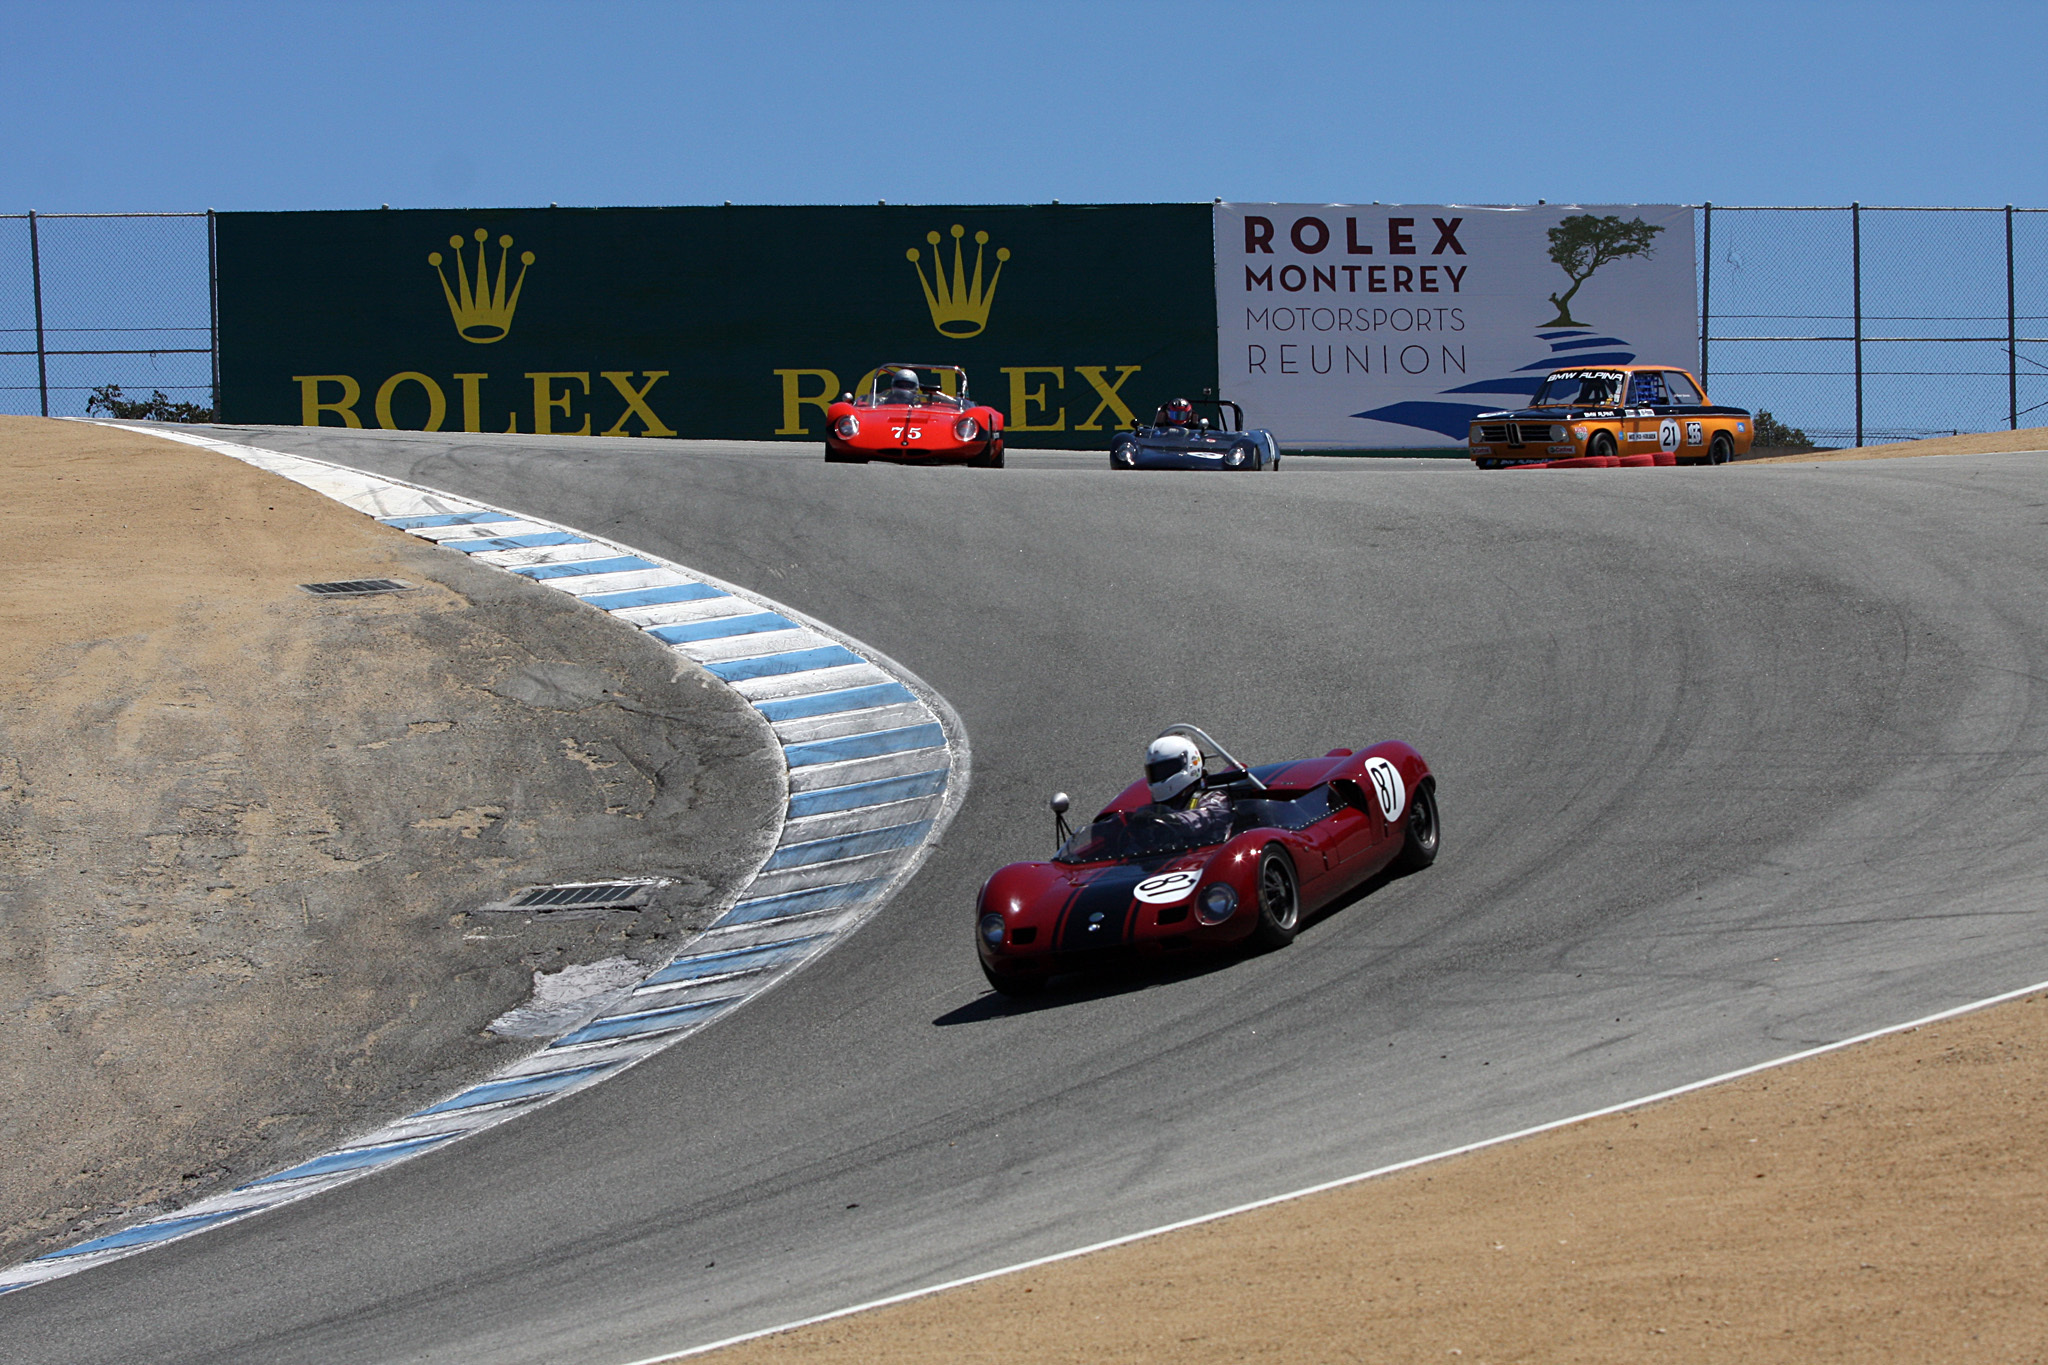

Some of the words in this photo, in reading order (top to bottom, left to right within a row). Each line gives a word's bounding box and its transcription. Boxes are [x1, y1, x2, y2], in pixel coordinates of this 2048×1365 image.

[1244, 215, 1467, 255] ROLEX
[1245, 264, 1468, 293] MONTEREY
[1246, 307, 1465, 332] MOTORSPORTS
[1248, 344, 1466, 375] REUNION
[1547, 372, 1577, 382] BMW
[1579, 372, 1623, 381] ALPINA
[292, 371, 677, 437] ROLEX
[891, 426, 921, 439] 75
[1662, 426, 1676, 447] 21
[1371, 762, 1397, 814] 87
[1139, 874, 1197, 898] 87
